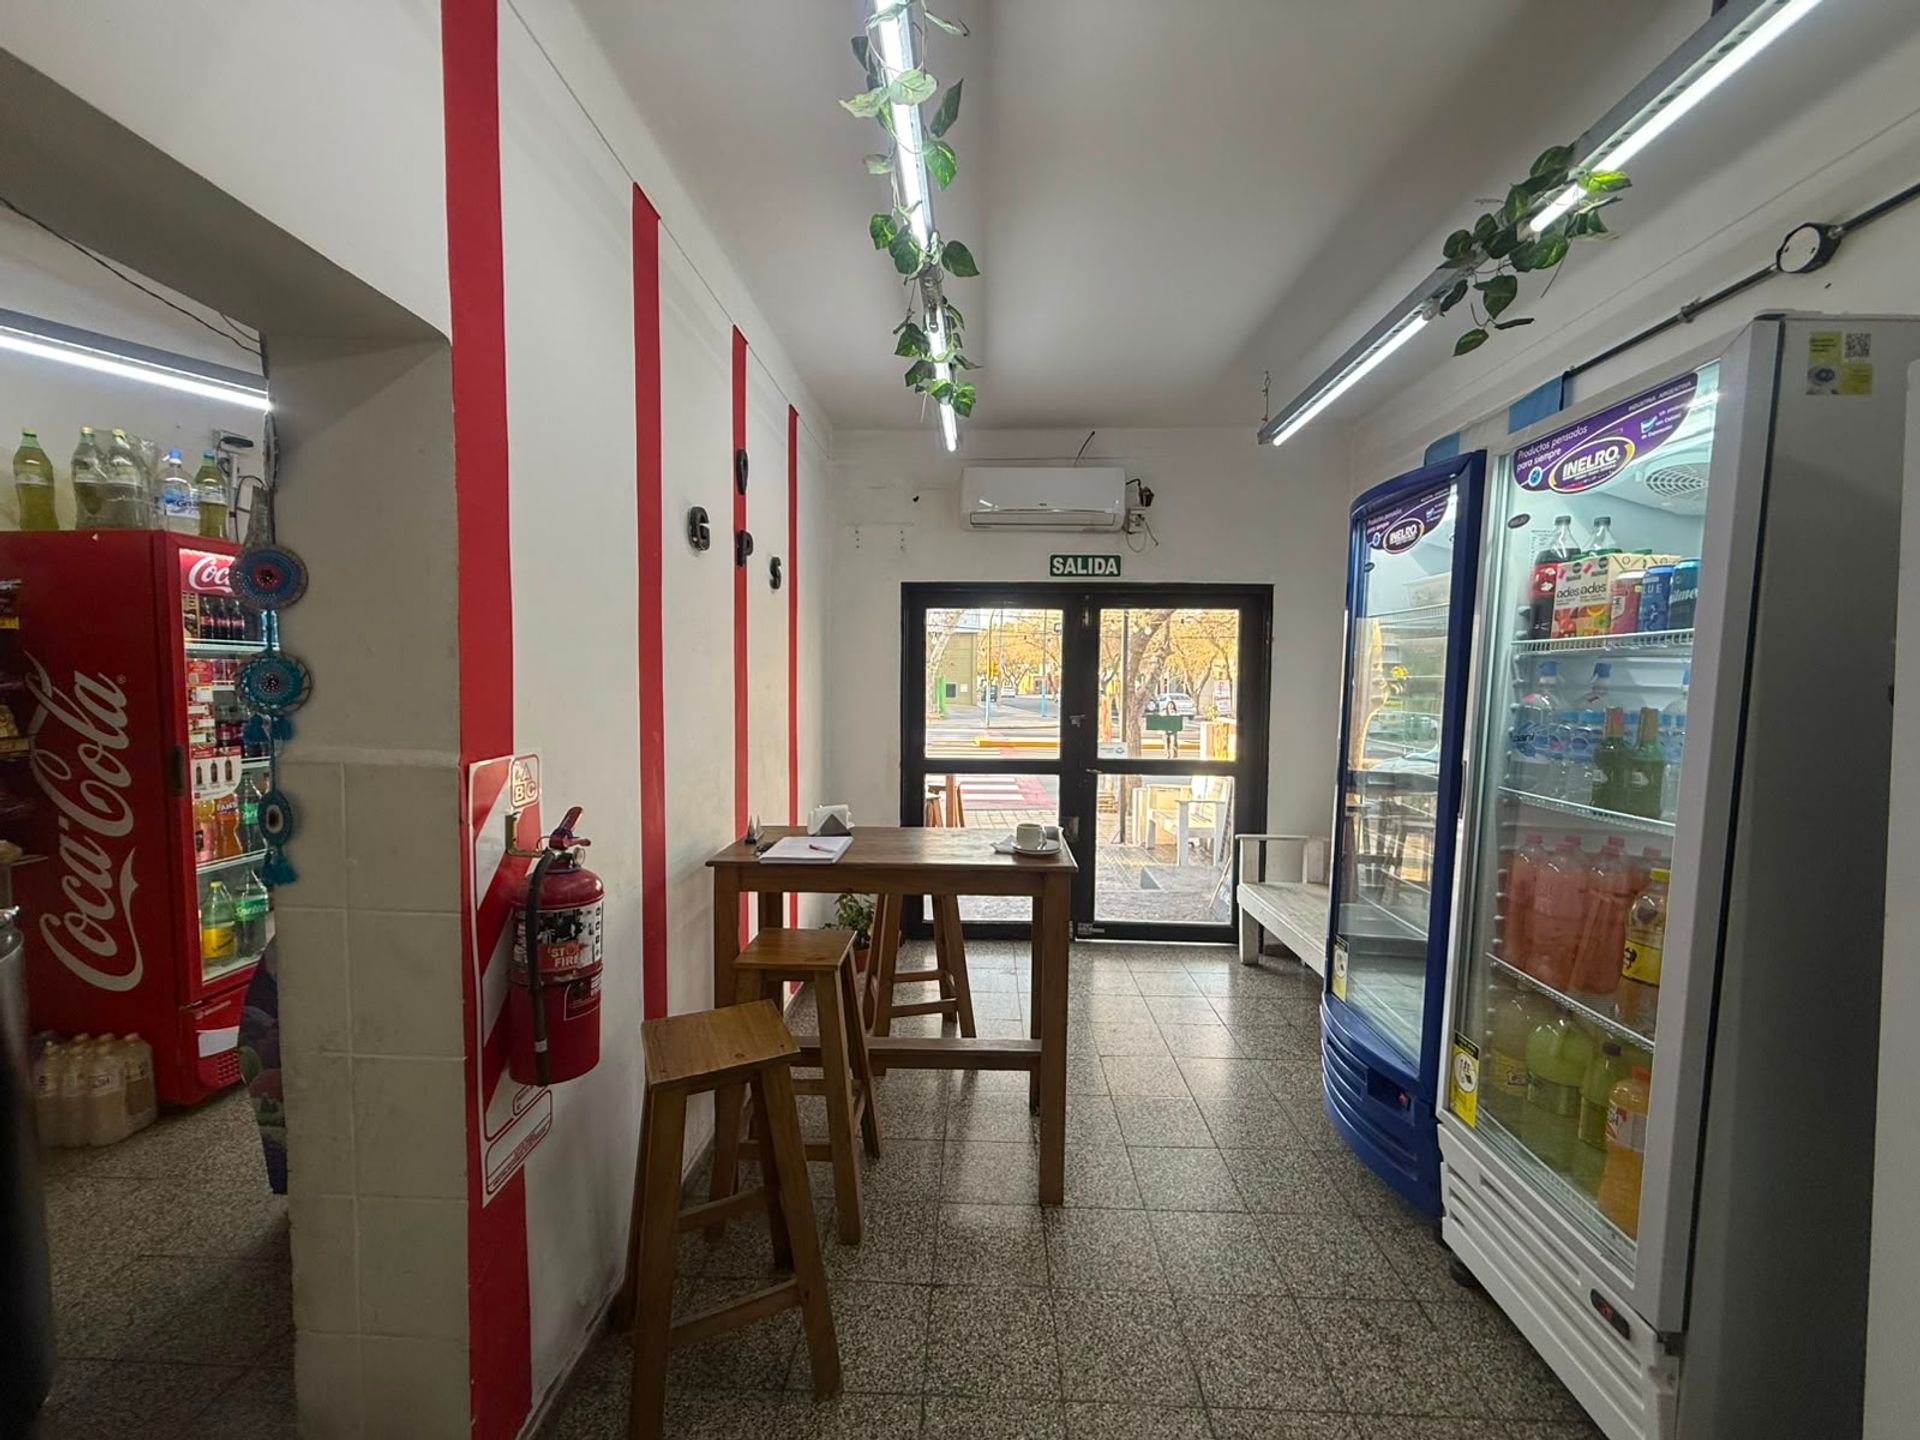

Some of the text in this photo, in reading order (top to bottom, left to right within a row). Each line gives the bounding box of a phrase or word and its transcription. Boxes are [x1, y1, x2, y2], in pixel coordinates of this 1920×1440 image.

[1517, 424, 1588, 461] Productos pensados
[1517, 447, 1562, 472] para siempre
[1562, 446, 1619, 477] INELRO
[1052, 557, 1119, 574] SALIDA
[1580, 582, 1607, 595] ades
